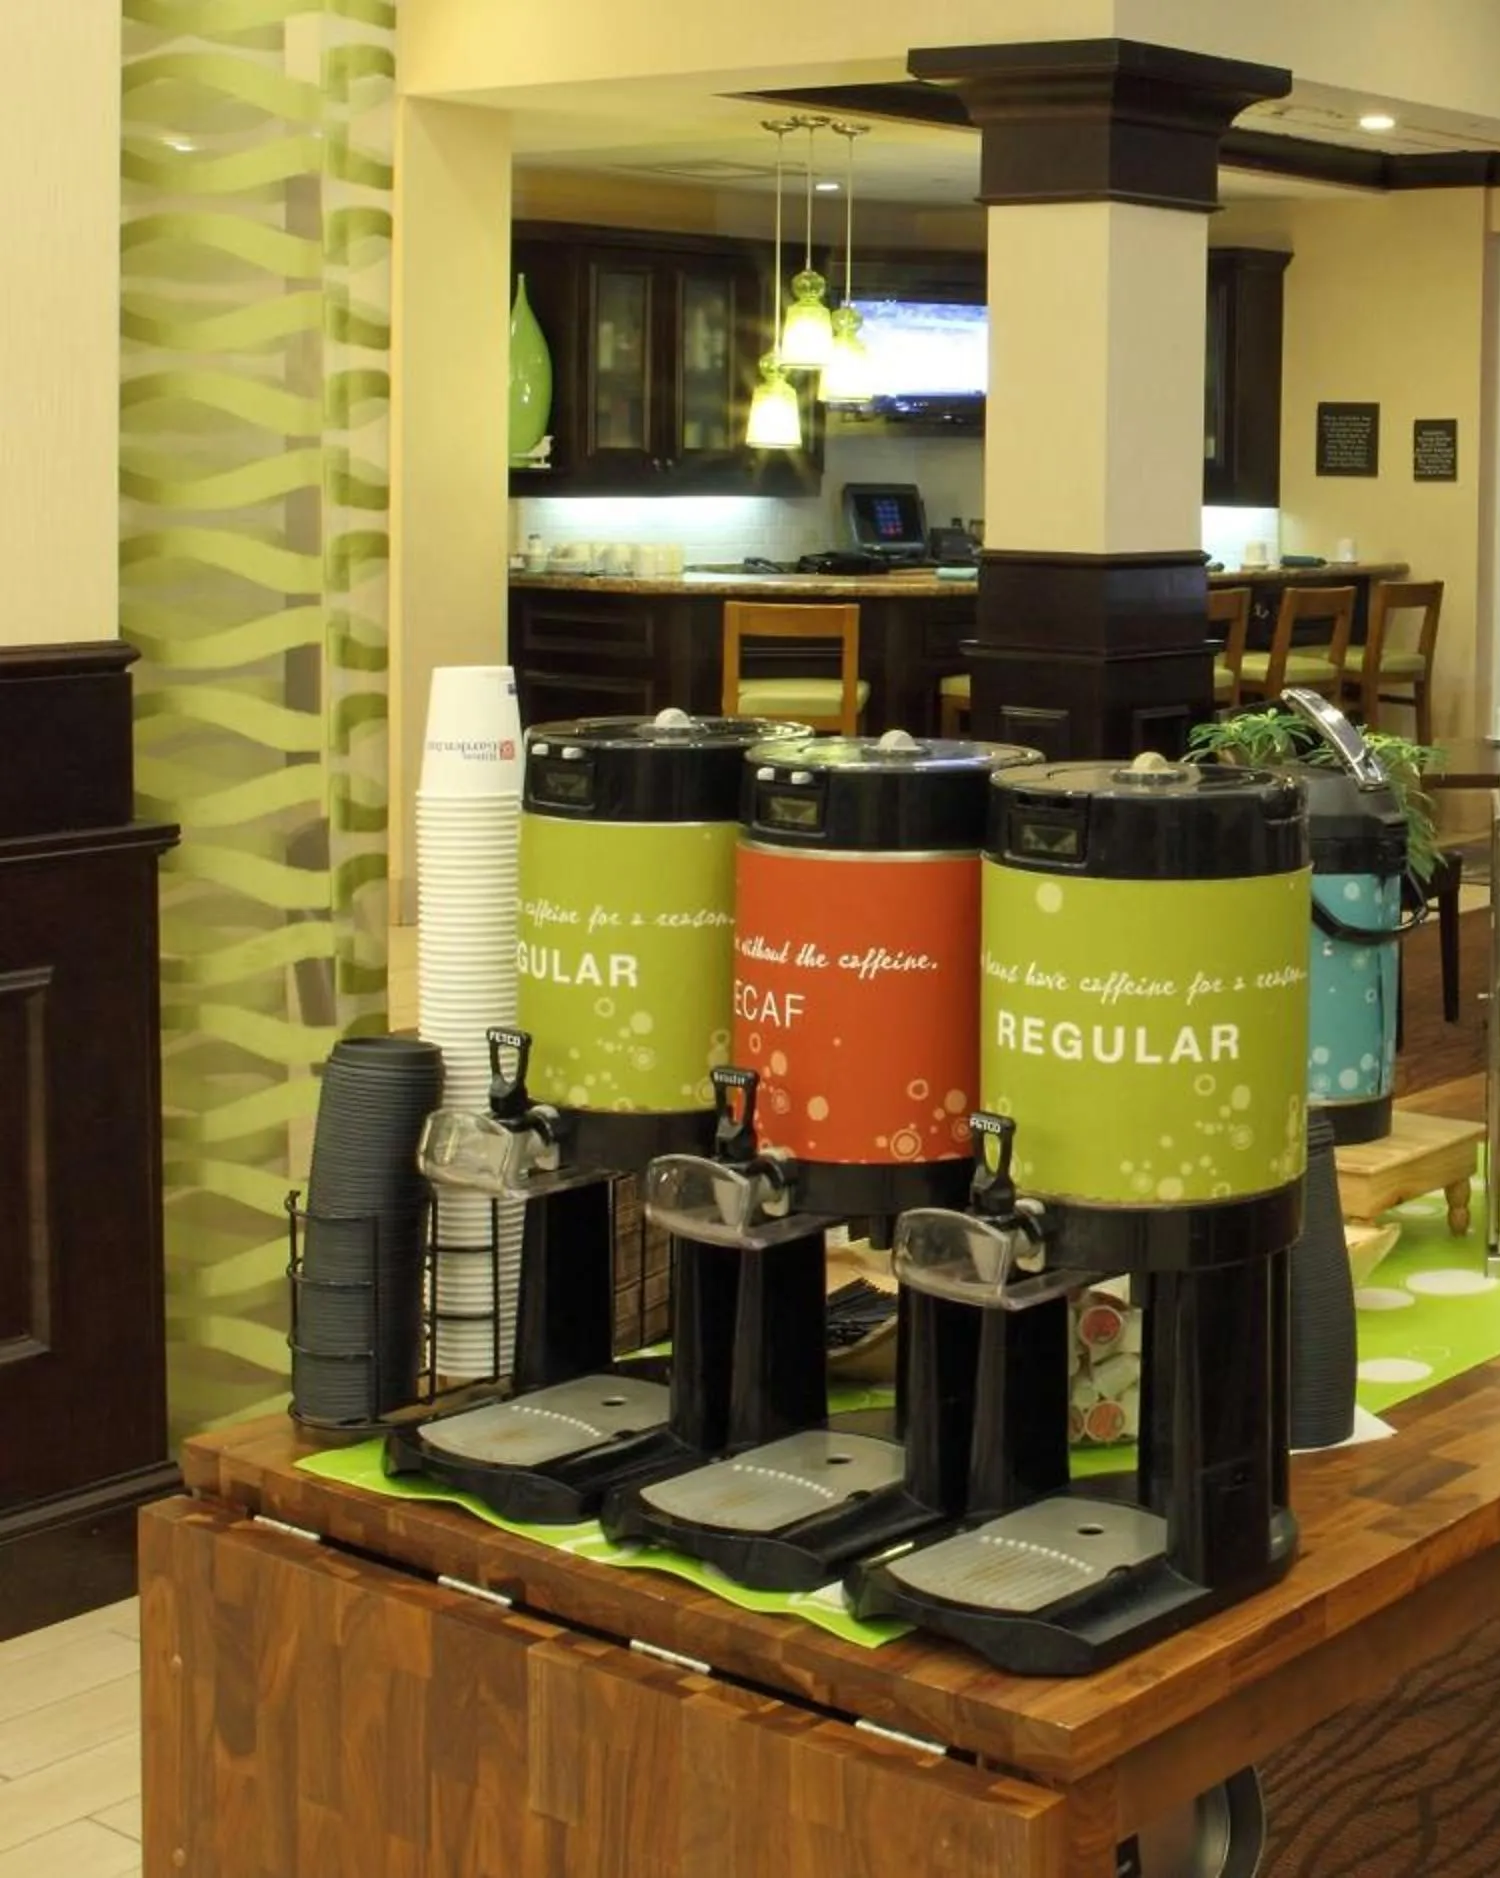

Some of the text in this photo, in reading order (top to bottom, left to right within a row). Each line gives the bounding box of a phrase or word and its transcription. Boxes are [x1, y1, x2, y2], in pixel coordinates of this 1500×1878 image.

[588, 905, 622, 934] for
[515, 940, 639, 989] GULAR
[794, 942, 830, 968] the
[838, 947, 938, 981] caffeine.
[1024, 961, 1071, 991] have
[1079, 971, 1178, 1006] caffeine
[1186, 971, 1226, 1006] for
[1233, 976, 1247, 991] a
[734, 979, 806, 1029] ECAF
[997, 1008, 1241, 1065] REGULAR
